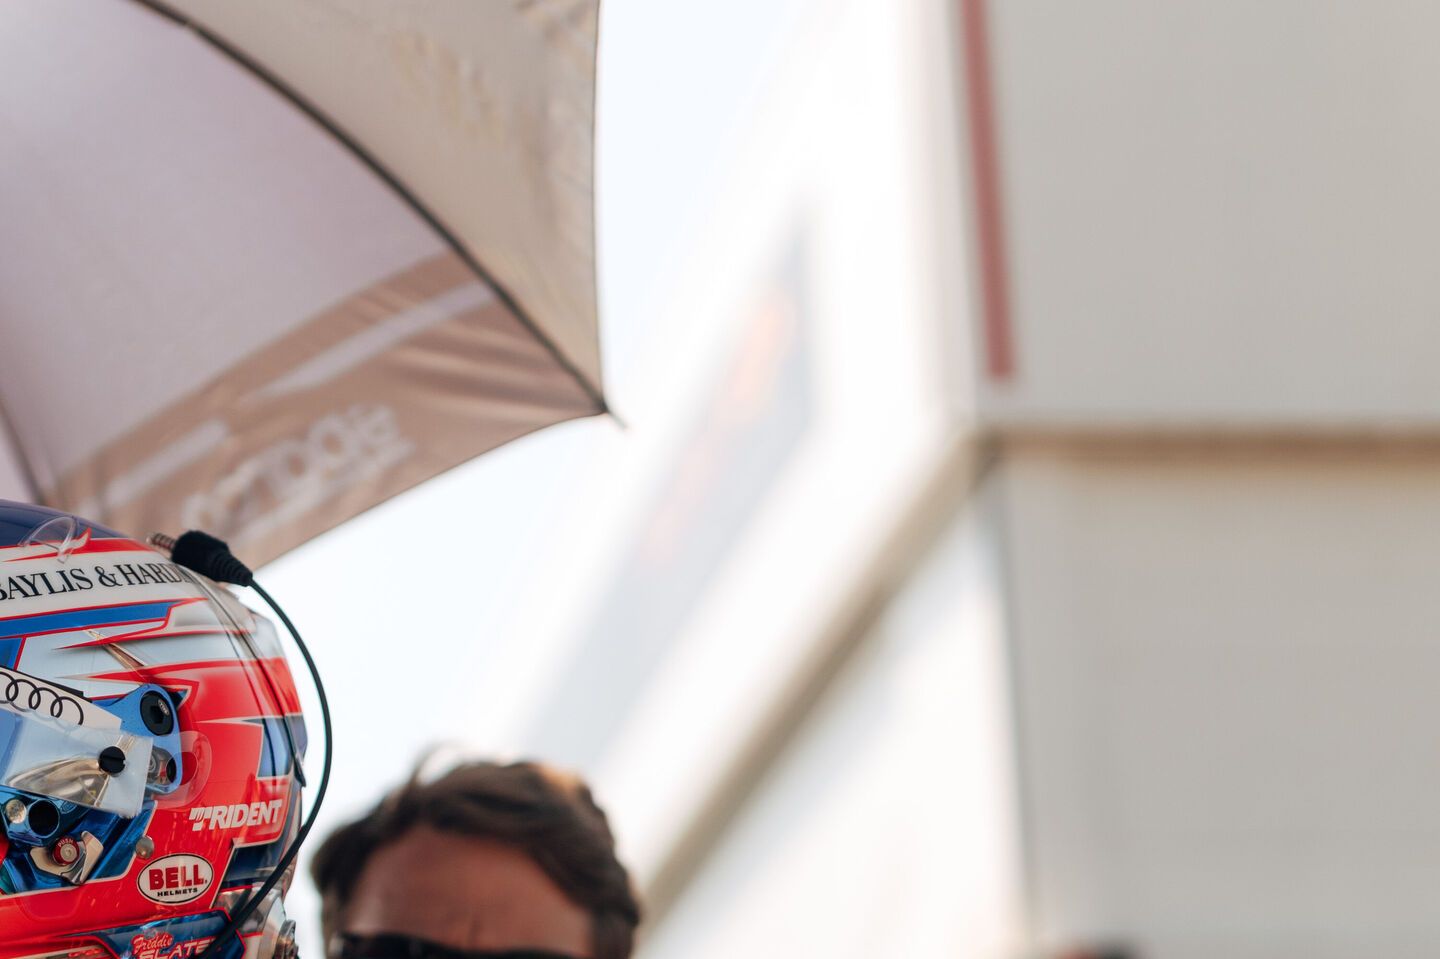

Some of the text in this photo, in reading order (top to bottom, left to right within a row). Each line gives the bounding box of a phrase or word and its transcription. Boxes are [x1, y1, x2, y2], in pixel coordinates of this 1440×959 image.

[97, 565, 123, 589] &
[189, 799, 283, 832] TRIDENT
[57, 838, 74, 848] PUSH
[148, 864, 205, 891] BELL
[157, 887, 198, 897] HELMETS
